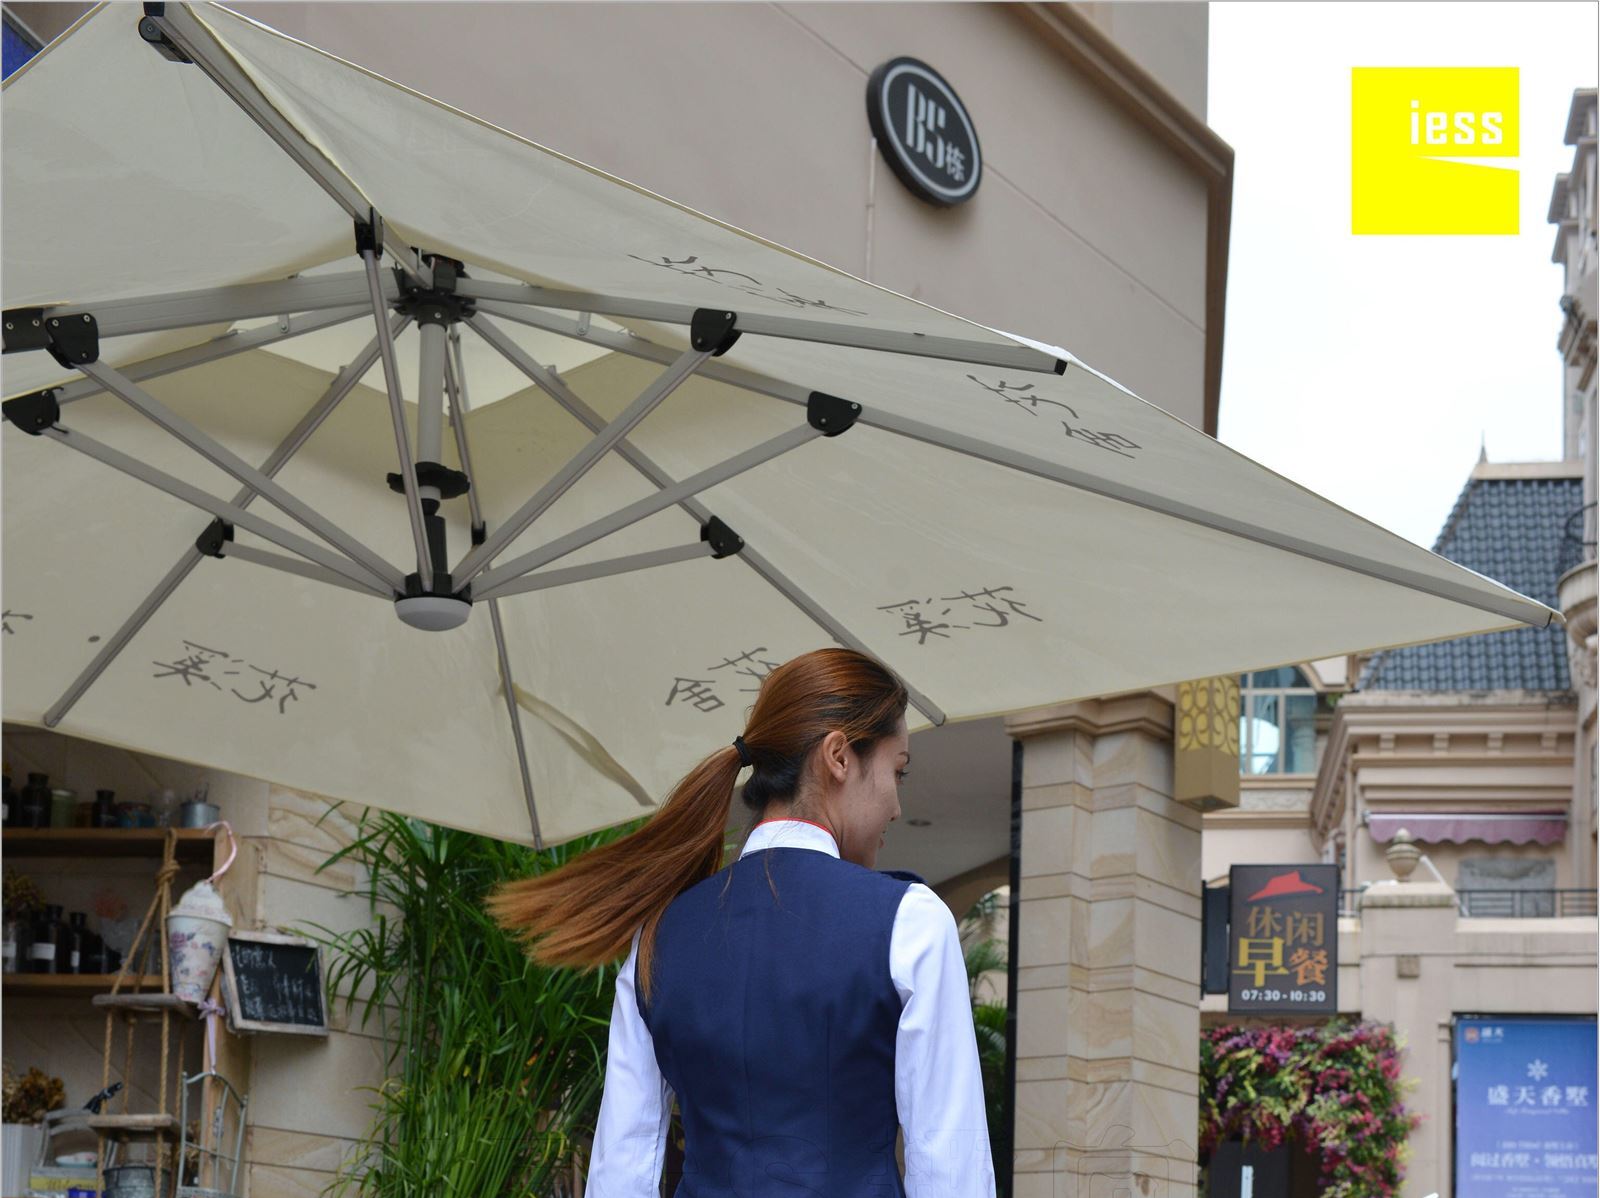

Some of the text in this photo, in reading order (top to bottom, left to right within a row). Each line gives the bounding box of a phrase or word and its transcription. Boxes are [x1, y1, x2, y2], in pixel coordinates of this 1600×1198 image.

[1247, 905, 1325, 947] 休闲
[1231, 936, 1329, 988] 早餐
[1487, 1084, 1589, 1107] 盛天香墅
